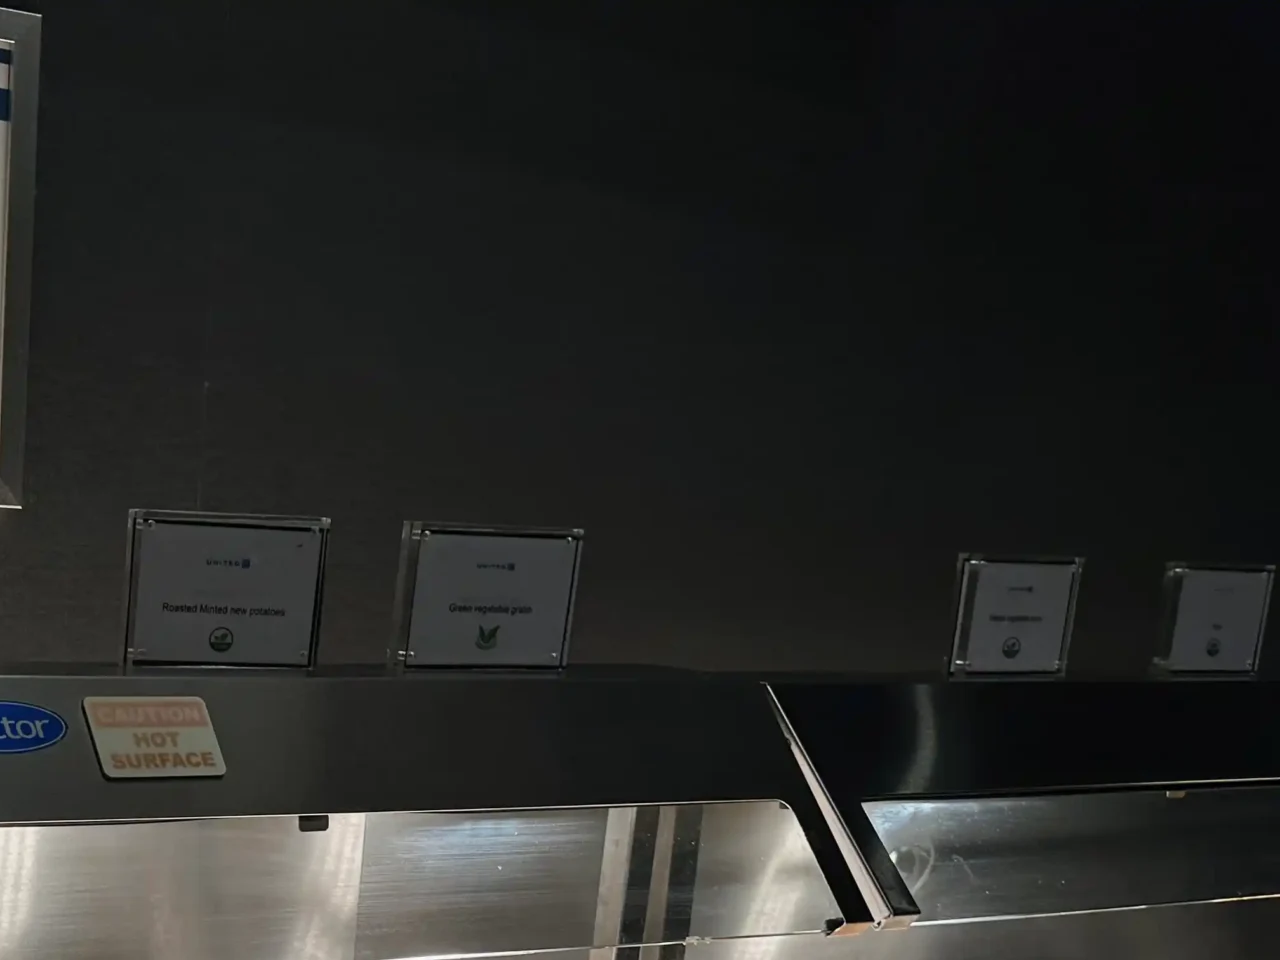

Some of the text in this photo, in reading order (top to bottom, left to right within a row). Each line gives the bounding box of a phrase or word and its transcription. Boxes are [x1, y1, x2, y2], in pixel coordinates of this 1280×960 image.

[162, 602, 285, 617] Roasted Minted new potatoes
[96, 706, 200, 723] CAUTION
[132, 731, 179, 748] HOT
[110, 752, 217, 770] SURFACE
